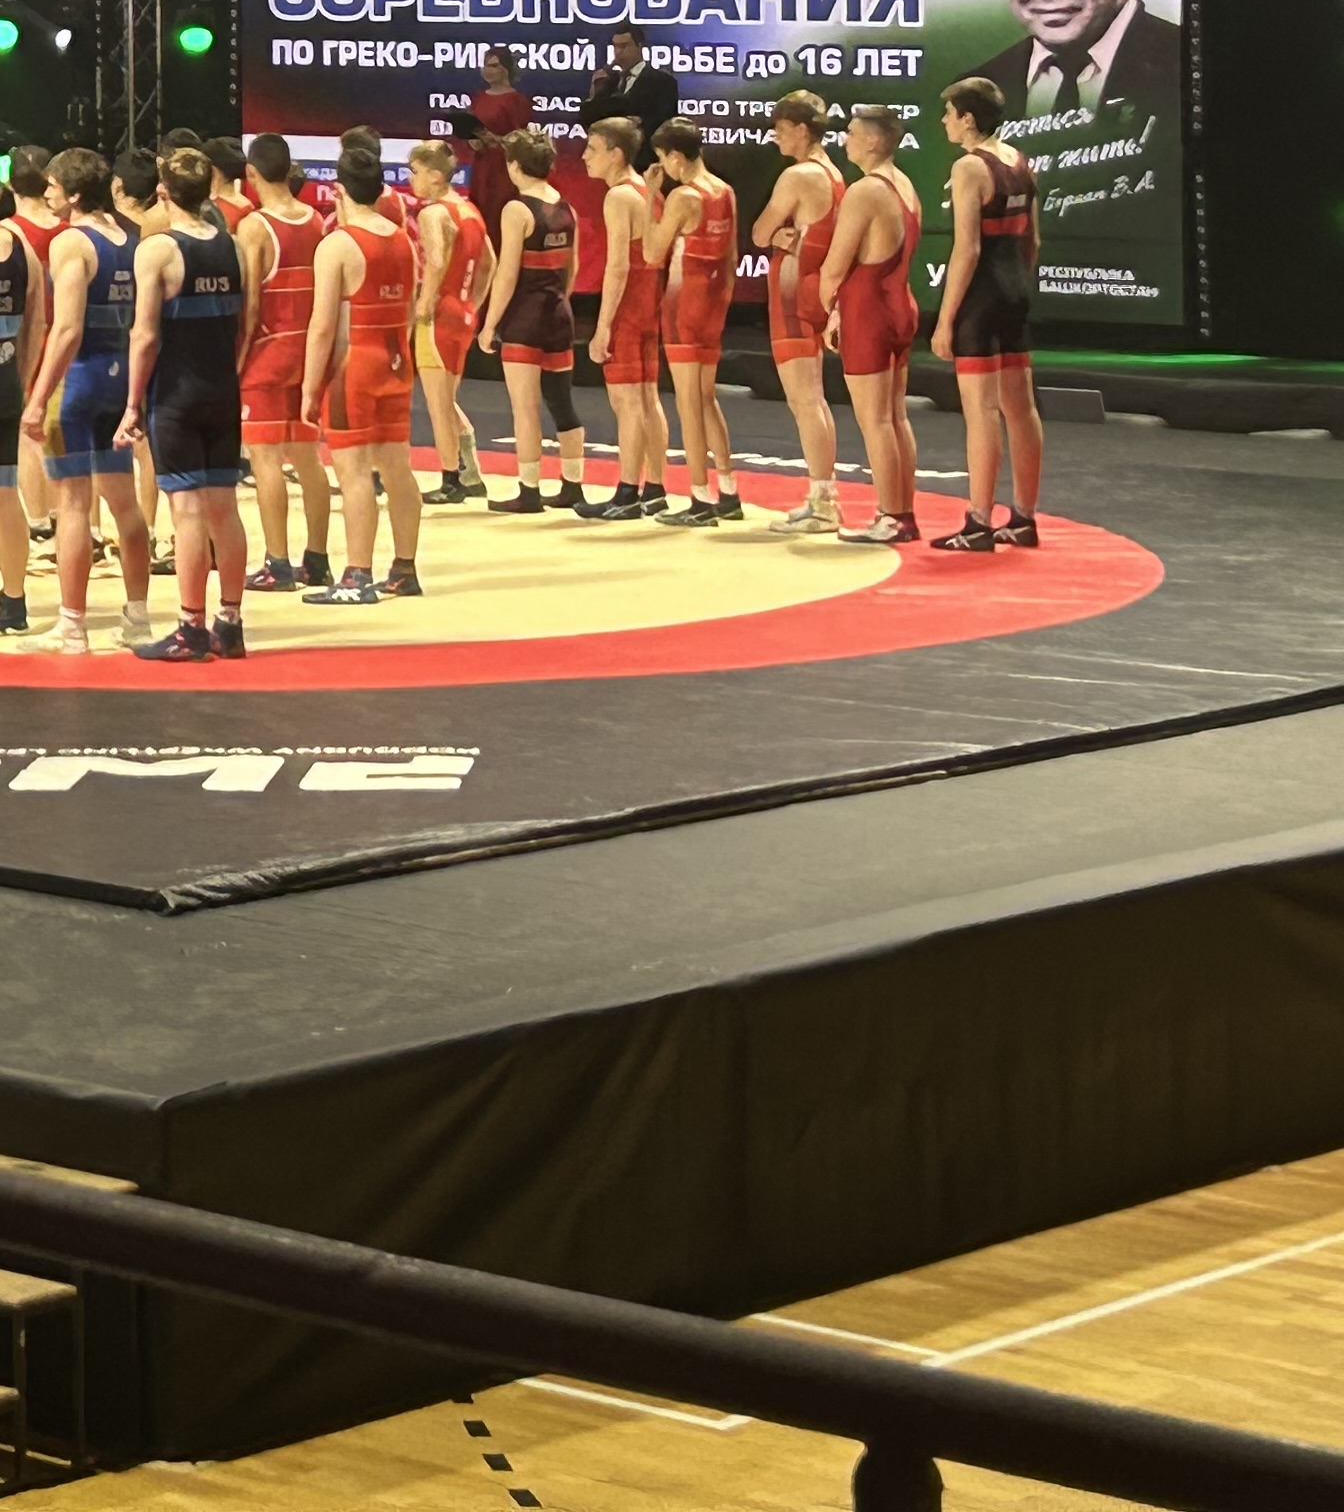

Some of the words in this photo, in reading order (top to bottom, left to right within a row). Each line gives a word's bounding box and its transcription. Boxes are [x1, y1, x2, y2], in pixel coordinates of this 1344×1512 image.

[271, 39, 314, 66] ПО
[606, 44, 736, 74] РЬБЕ
[745, 51, 787, 78] до
[797, 47, 843, 76] 16
[852, 48, 924, 77] ЛЕТ
[194, 275, 231, 293] RUS
